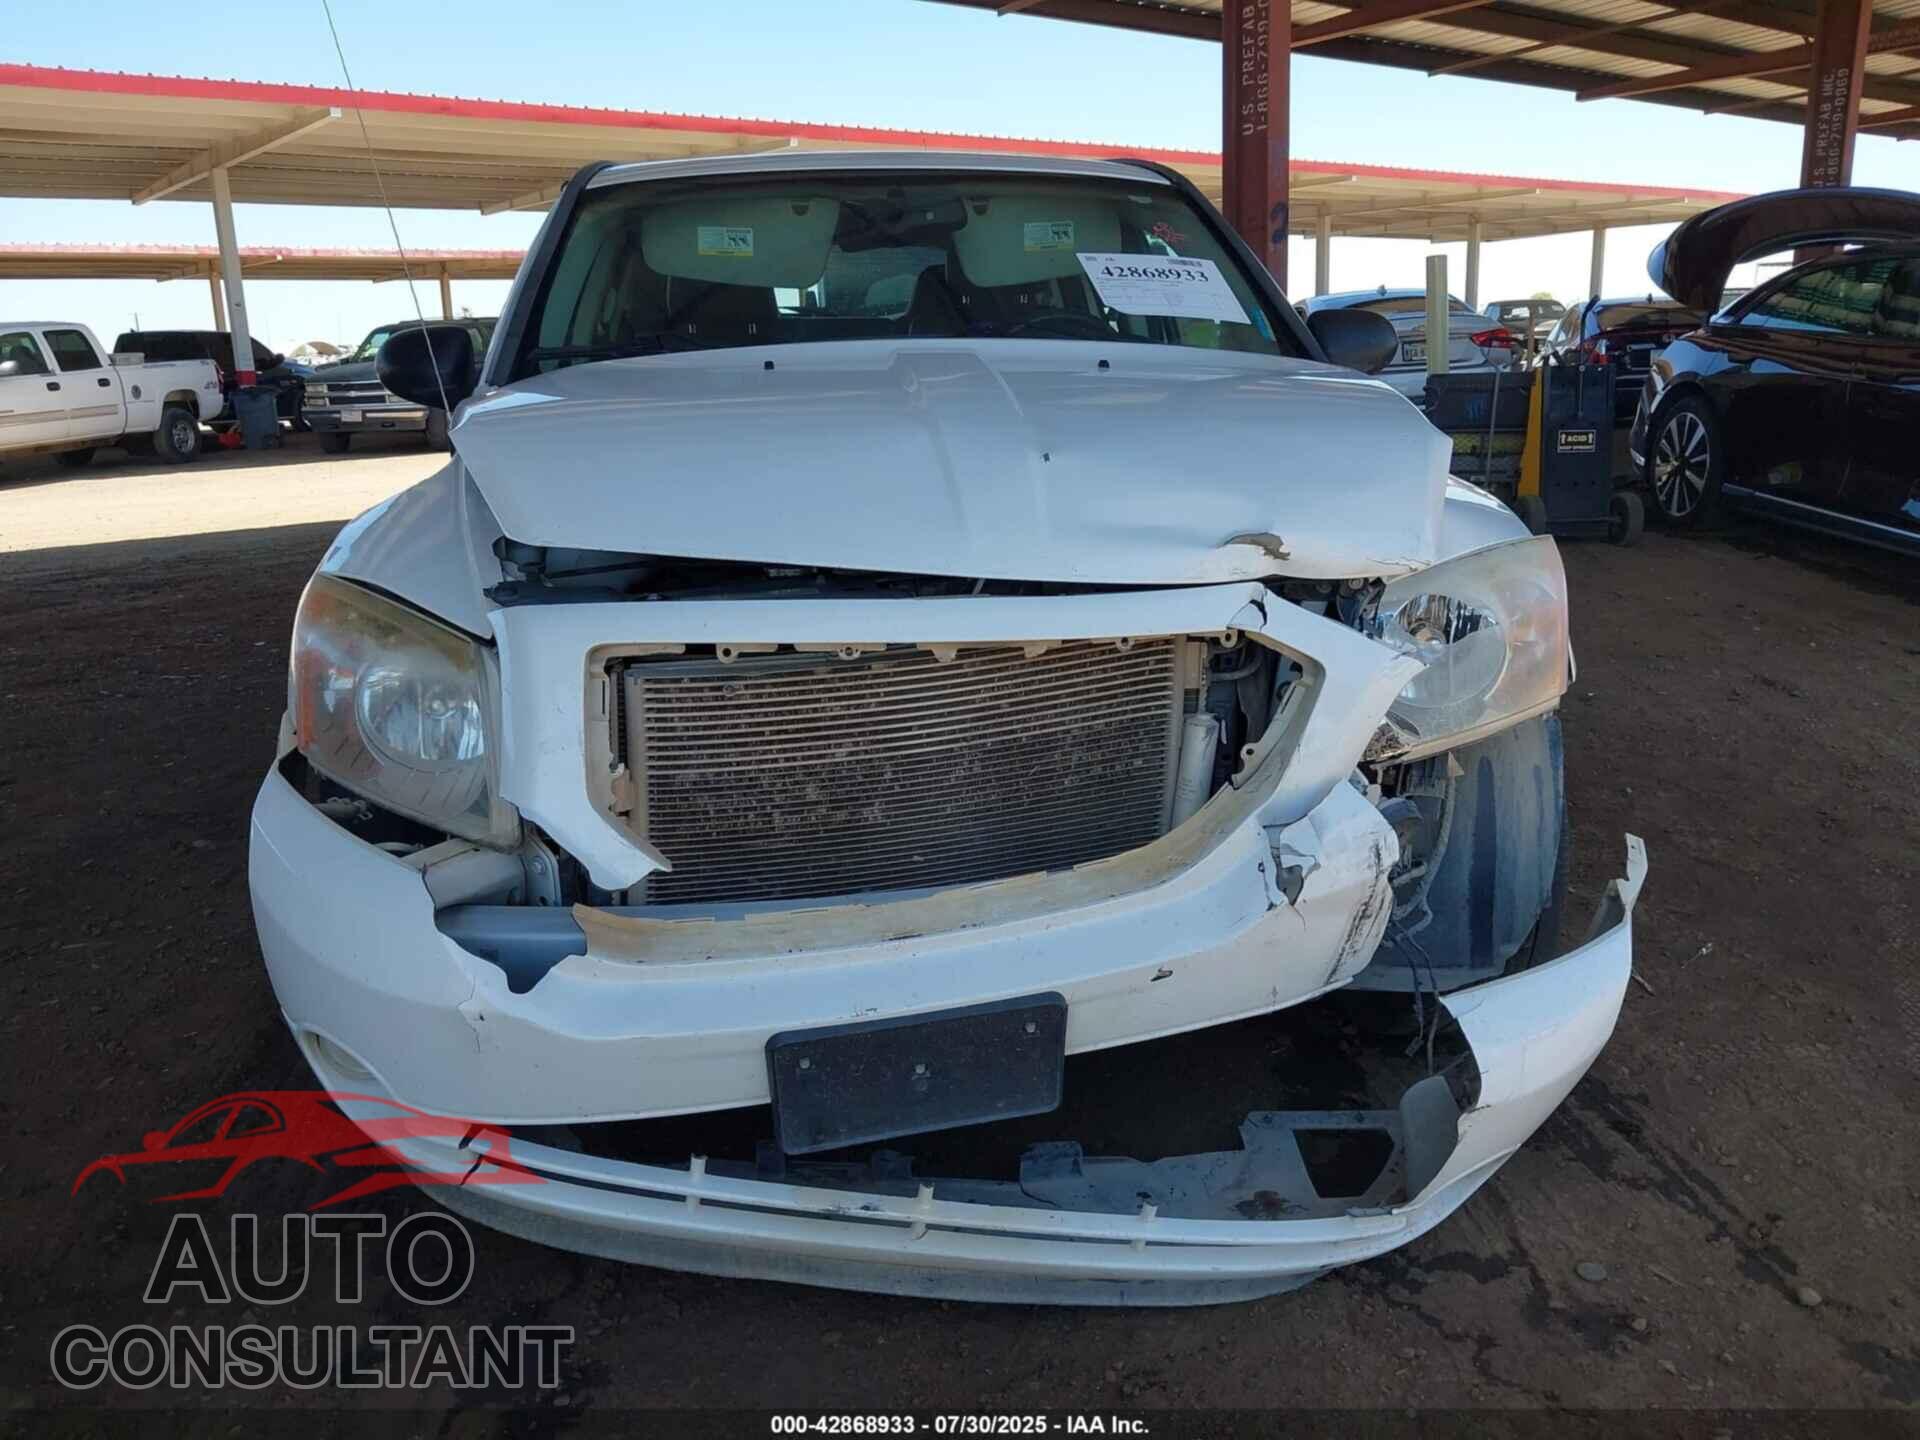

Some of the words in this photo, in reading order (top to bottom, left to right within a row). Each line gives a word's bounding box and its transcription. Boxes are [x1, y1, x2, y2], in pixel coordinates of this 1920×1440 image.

[1242, 6, 1255, 86] PREFAB
[1816, 103, 1832, 156] PREFAB
[1101, 265, 1209, 282] 42868933
